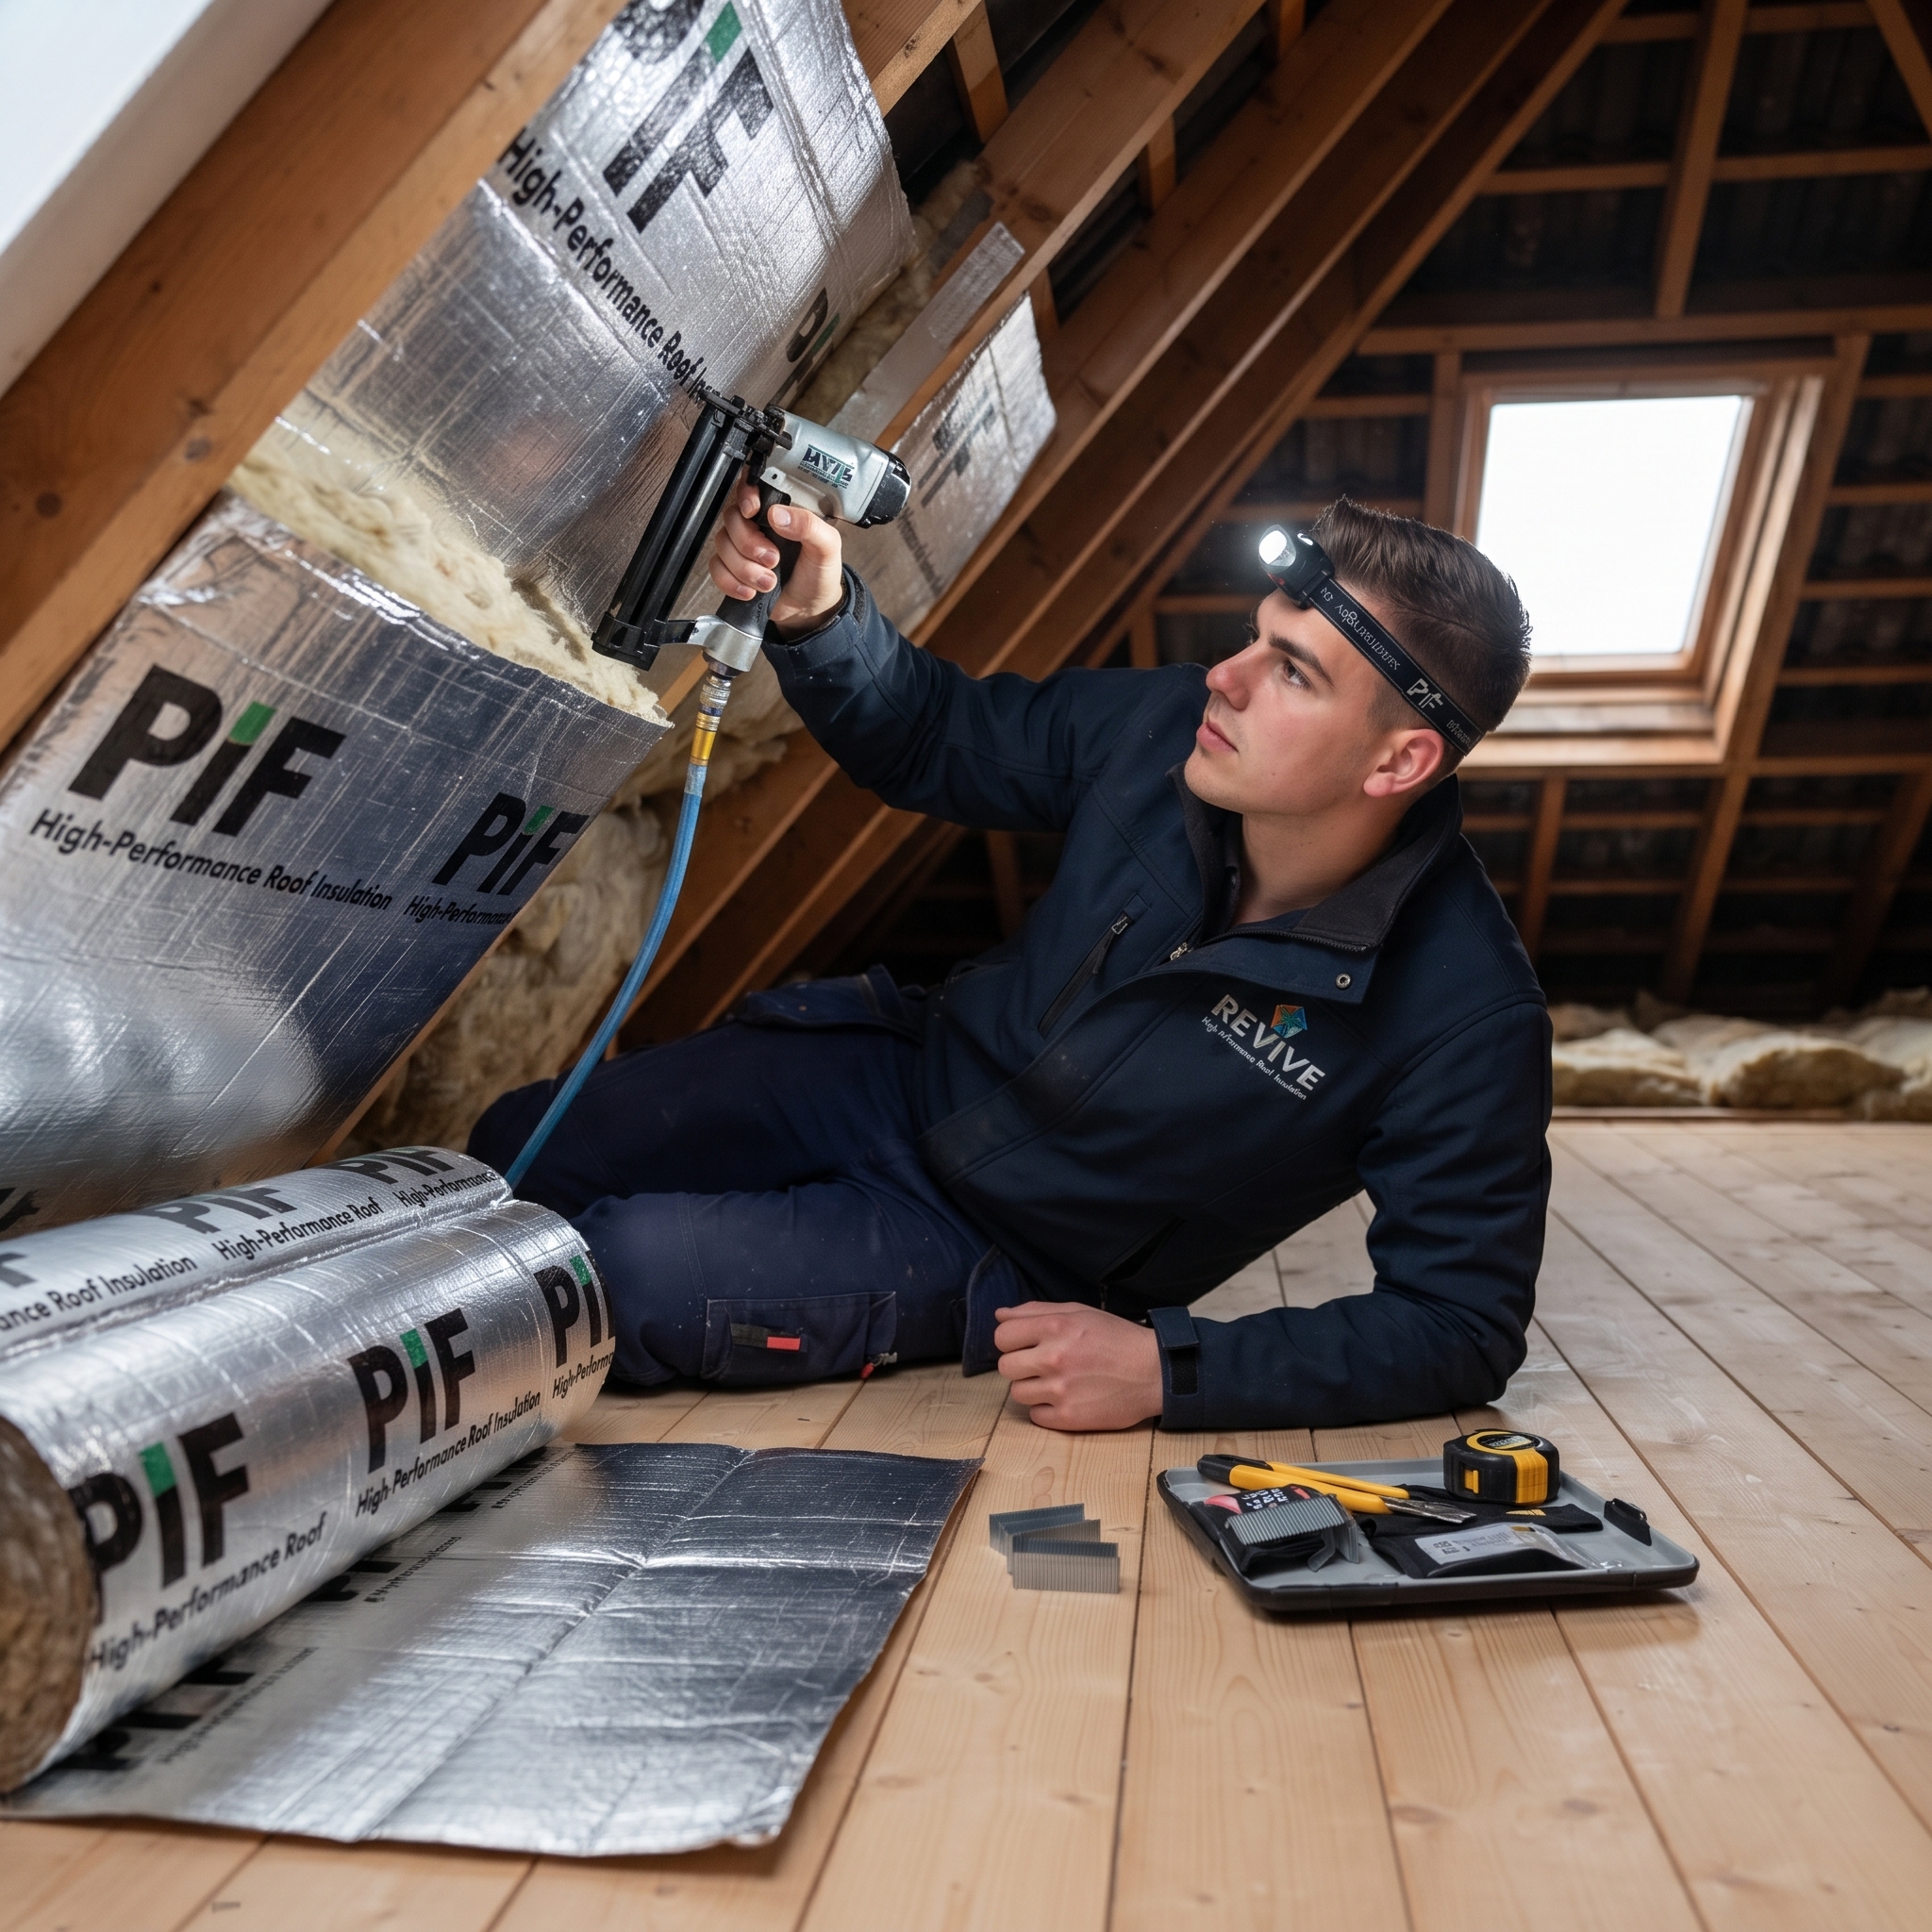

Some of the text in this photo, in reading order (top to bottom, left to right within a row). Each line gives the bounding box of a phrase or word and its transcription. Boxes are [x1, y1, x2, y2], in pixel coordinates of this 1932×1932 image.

[497, 127, 704, 387] High-Performance Roof
[29, 808, 393, 911] High-Performance Roof Insulation
[1210, 993, 1325, 1091] REVIVE
[211, 1197, 384, 1262] High-Performance Roof
[46, 1279, 103, 1311] Roof
[98, 1256, 198, 1296] Insulation
[356, 1437, 466, 1517] High-Performance
[467, 1422, 492, 1448] Roof
[492, 1390, 541, 1434] Insulation
[284, 1510, 328, 1561] Roof
